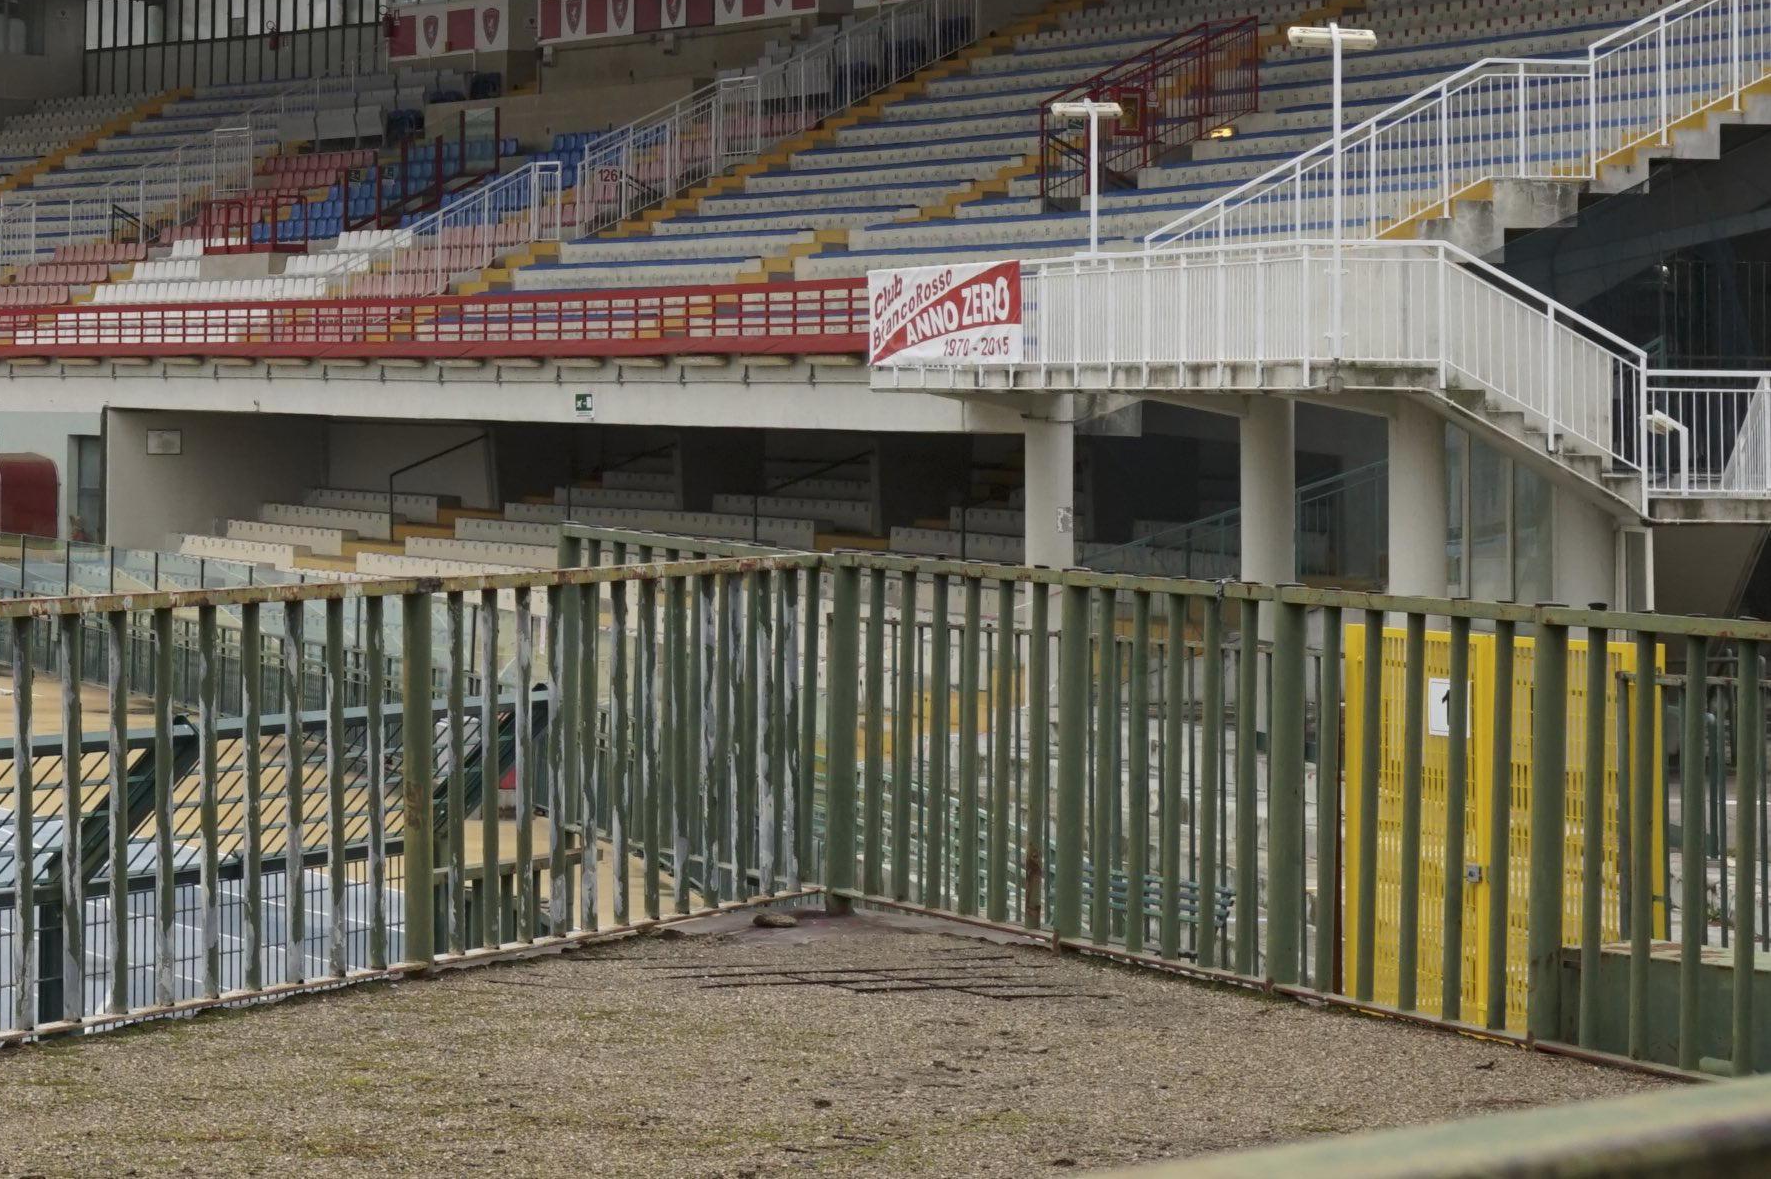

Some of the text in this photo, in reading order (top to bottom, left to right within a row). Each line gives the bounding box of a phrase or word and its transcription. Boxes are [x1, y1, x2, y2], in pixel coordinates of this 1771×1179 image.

[598, 168, 618, 182] 126
[873, 269, 953, 349] BiancoRosso
[874, 274, 903, 320] Club
[906, 276, 1010, 346] ANNO ZERO
[943, 338, 970, 357] 1970
[980, 337, 1010, 356] 2015
